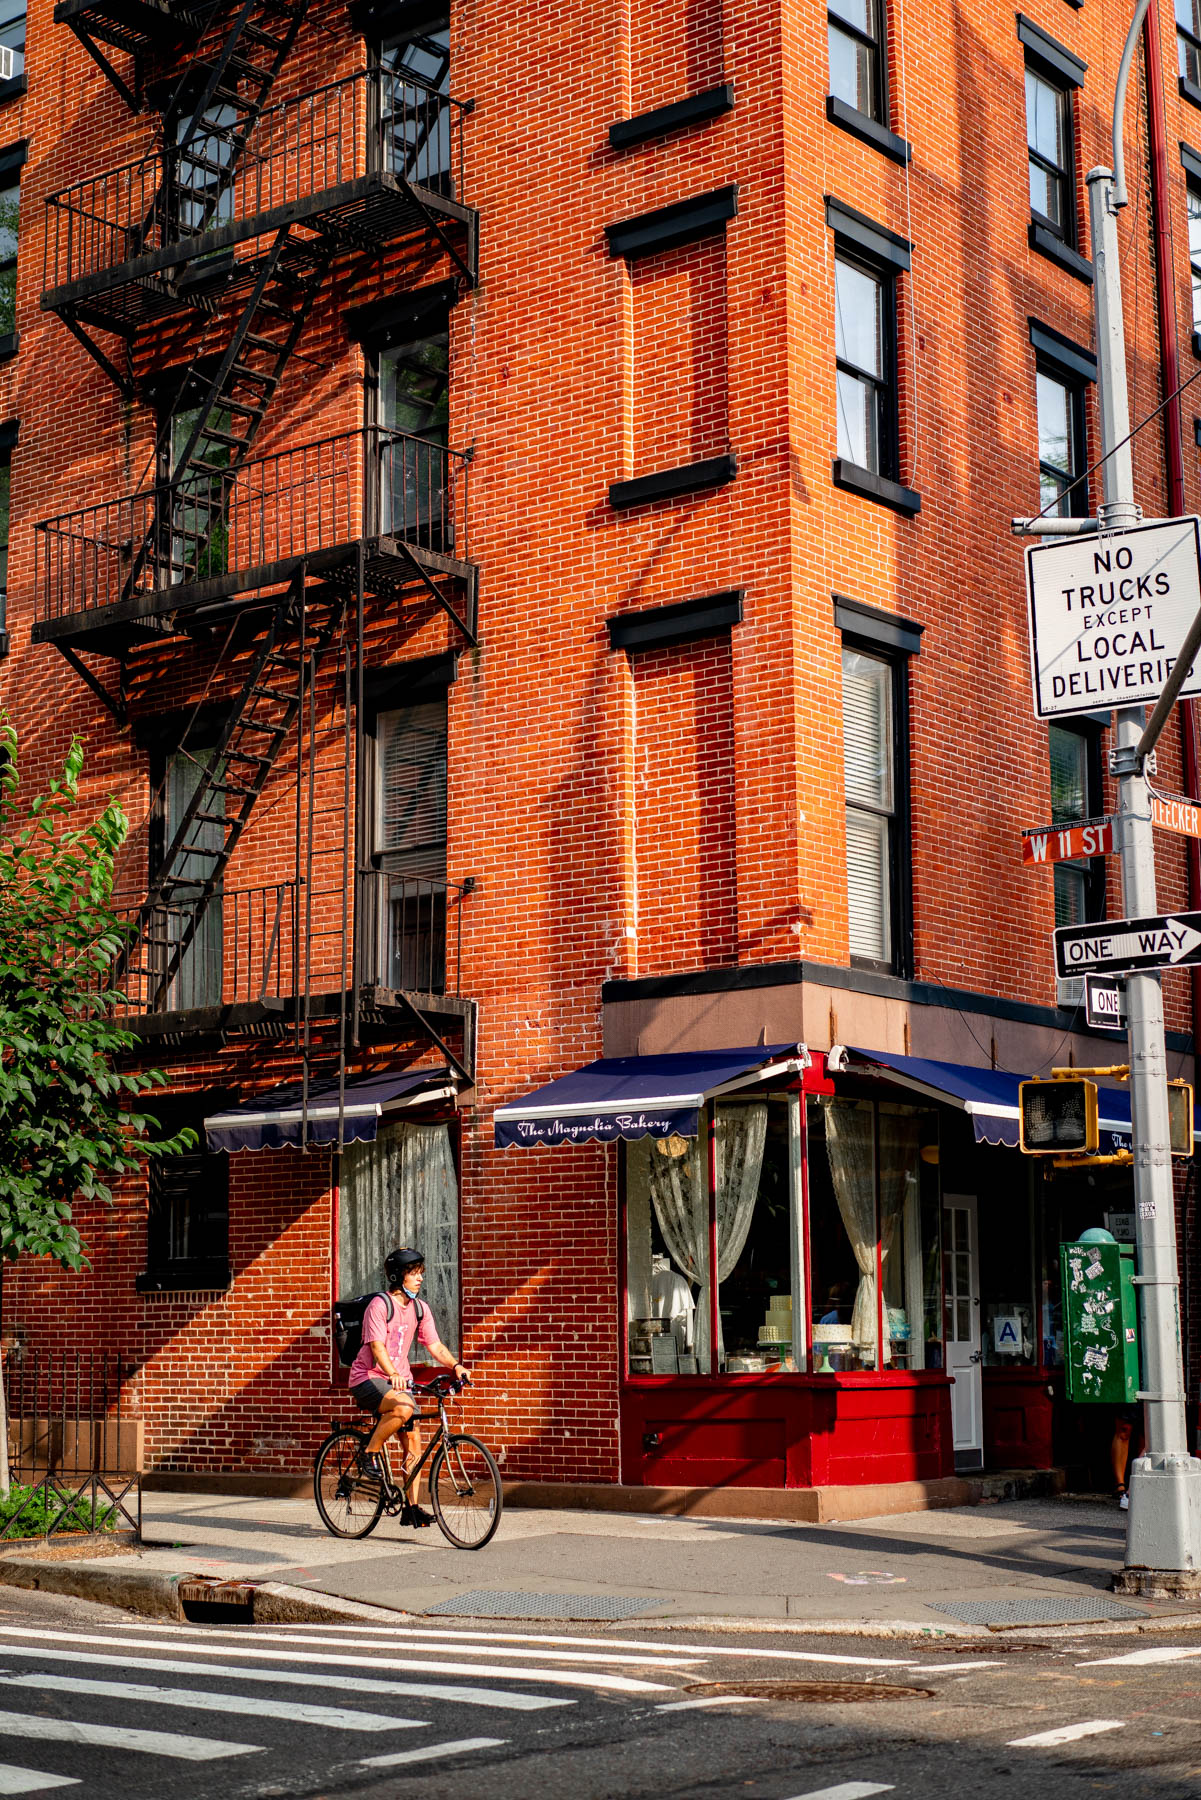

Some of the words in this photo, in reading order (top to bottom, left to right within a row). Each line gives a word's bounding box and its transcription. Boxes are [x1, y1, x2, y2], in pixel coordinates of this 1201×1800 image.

[1094, 547, 1133, 575] NO
[1062, 572, 1170, 611] TRUCKS
[1083, 605, 1153, 630] EXCEPT
[1077, 628, 1165, 662] LOCAL
[1030, 834, 1048, 863] W
[1058, 831, 1072, 859] 11
[1082, 822, 1108, 855] ST
[1069, 938, 1113, 962] ONE
[1138, 929, 1188, 953] WAY
[1098, 991, 1119, 1013] ONE
[518, 1121, 545, 1137] The
[548, 1114, 614, 1138] Magnolia
[616, 1114, 672, 1132] Bakery
[1111, 1132, 1128, 1147] The
[999, 1321, 1017, 1342] A
